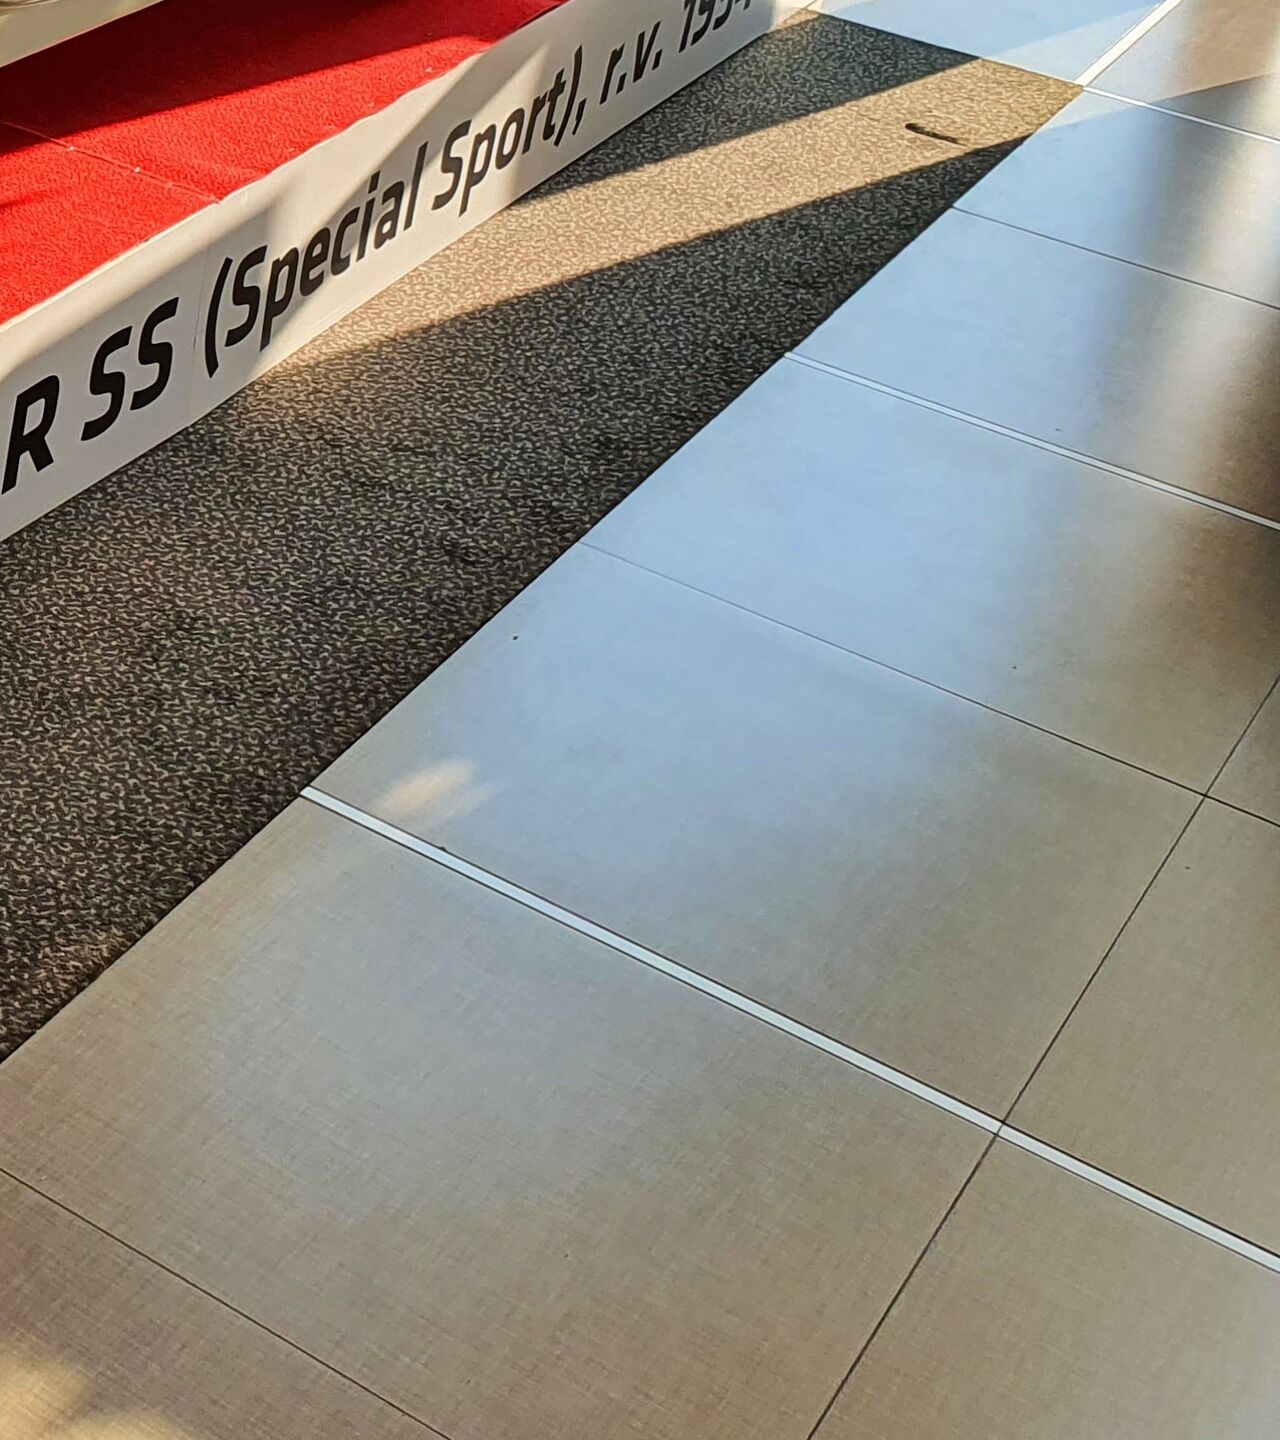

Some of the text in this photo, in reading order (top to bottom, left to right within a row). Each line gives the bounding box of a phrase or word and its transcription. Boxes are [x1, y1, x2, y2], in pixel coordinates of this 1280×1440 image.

[80, 296, 180, 442] SS
[204, 142, 429, 380] (Special
[431, 45, 588, 218] Sport),
[599, 20, 663, 105] r.v.
